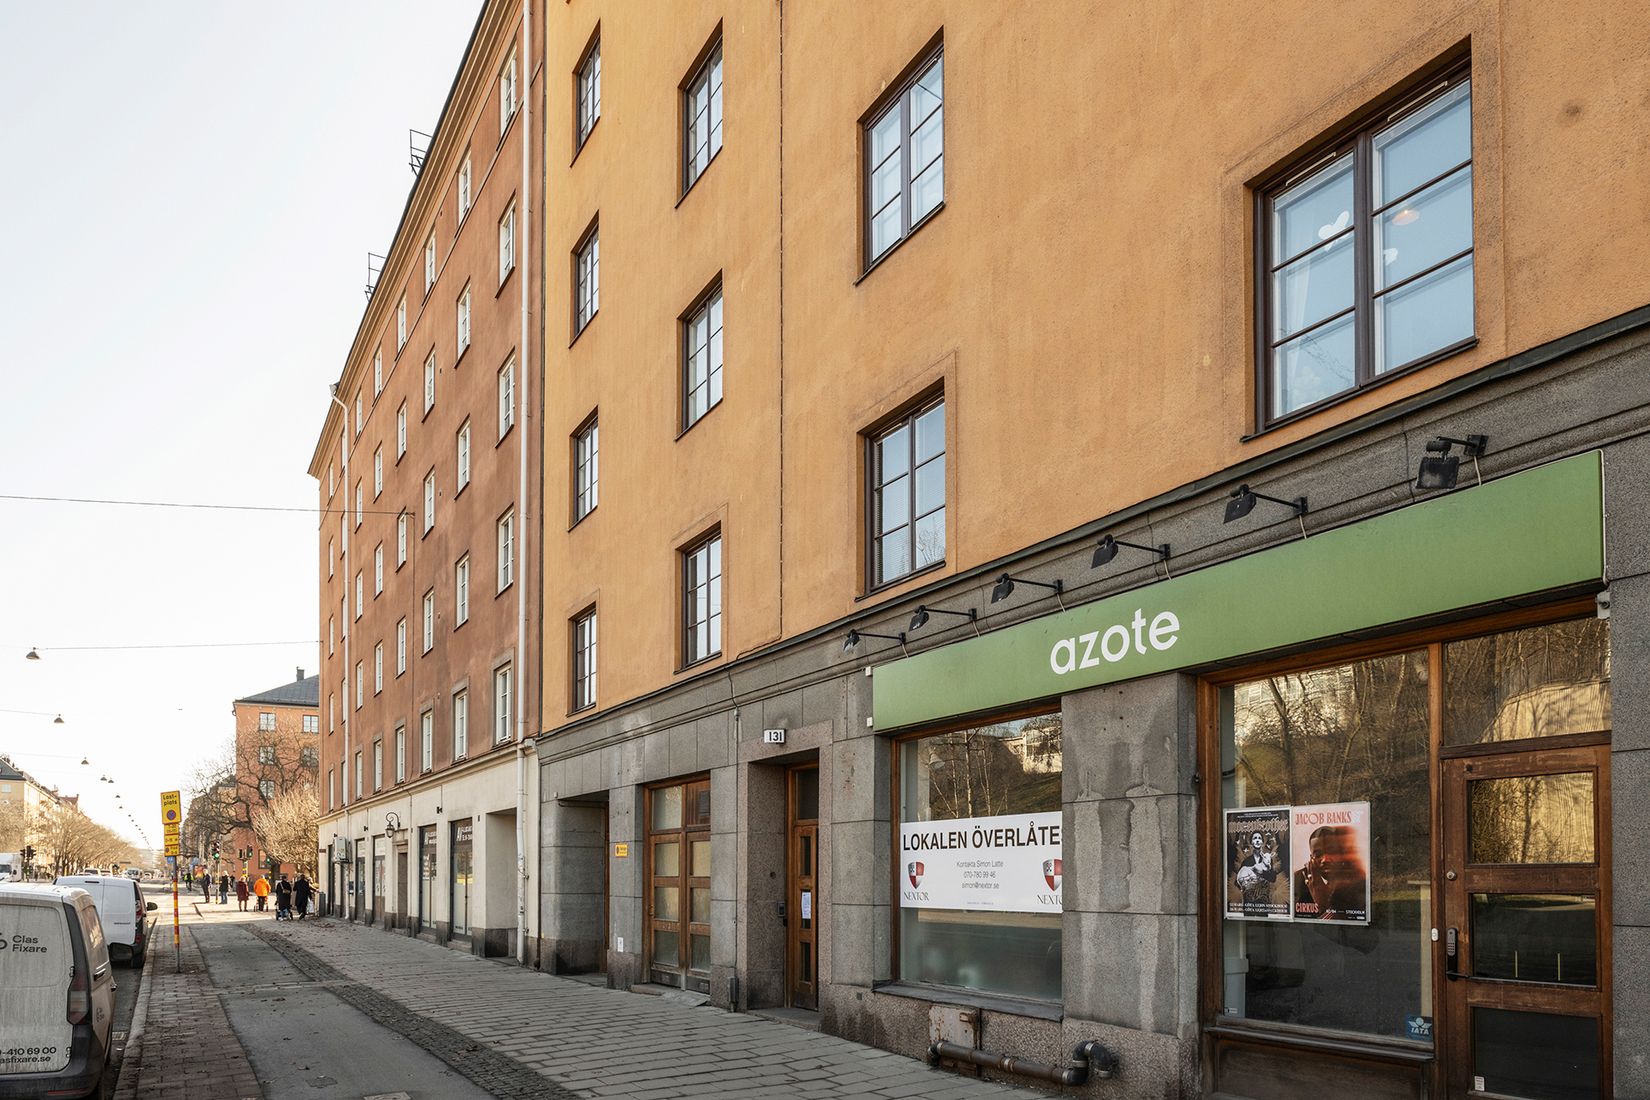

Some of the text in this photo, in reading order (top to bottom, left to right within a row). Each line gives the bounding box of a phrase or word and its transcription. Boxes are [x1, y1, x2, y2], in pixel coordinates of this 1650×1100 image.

[1050, 608, 1180, 675] azote
[769, 731, 782, 742] 131
[1295, 812, 1325, 825] JACOB
[1327, 810, 1352, 824] BANKS
[903, 821, 1063, 850] LOKALEN ÖVERLÅTE
[903, 891, 929, 901] NEXTOR
[1295, 902, 1319, 913] CIRKUS
[12, 935, 39, 944] Clas
[12, 944, 48, 953] Fixare
[27, 1047, 40, 1055] 69
[42, 1046, 57, 1054] 00
